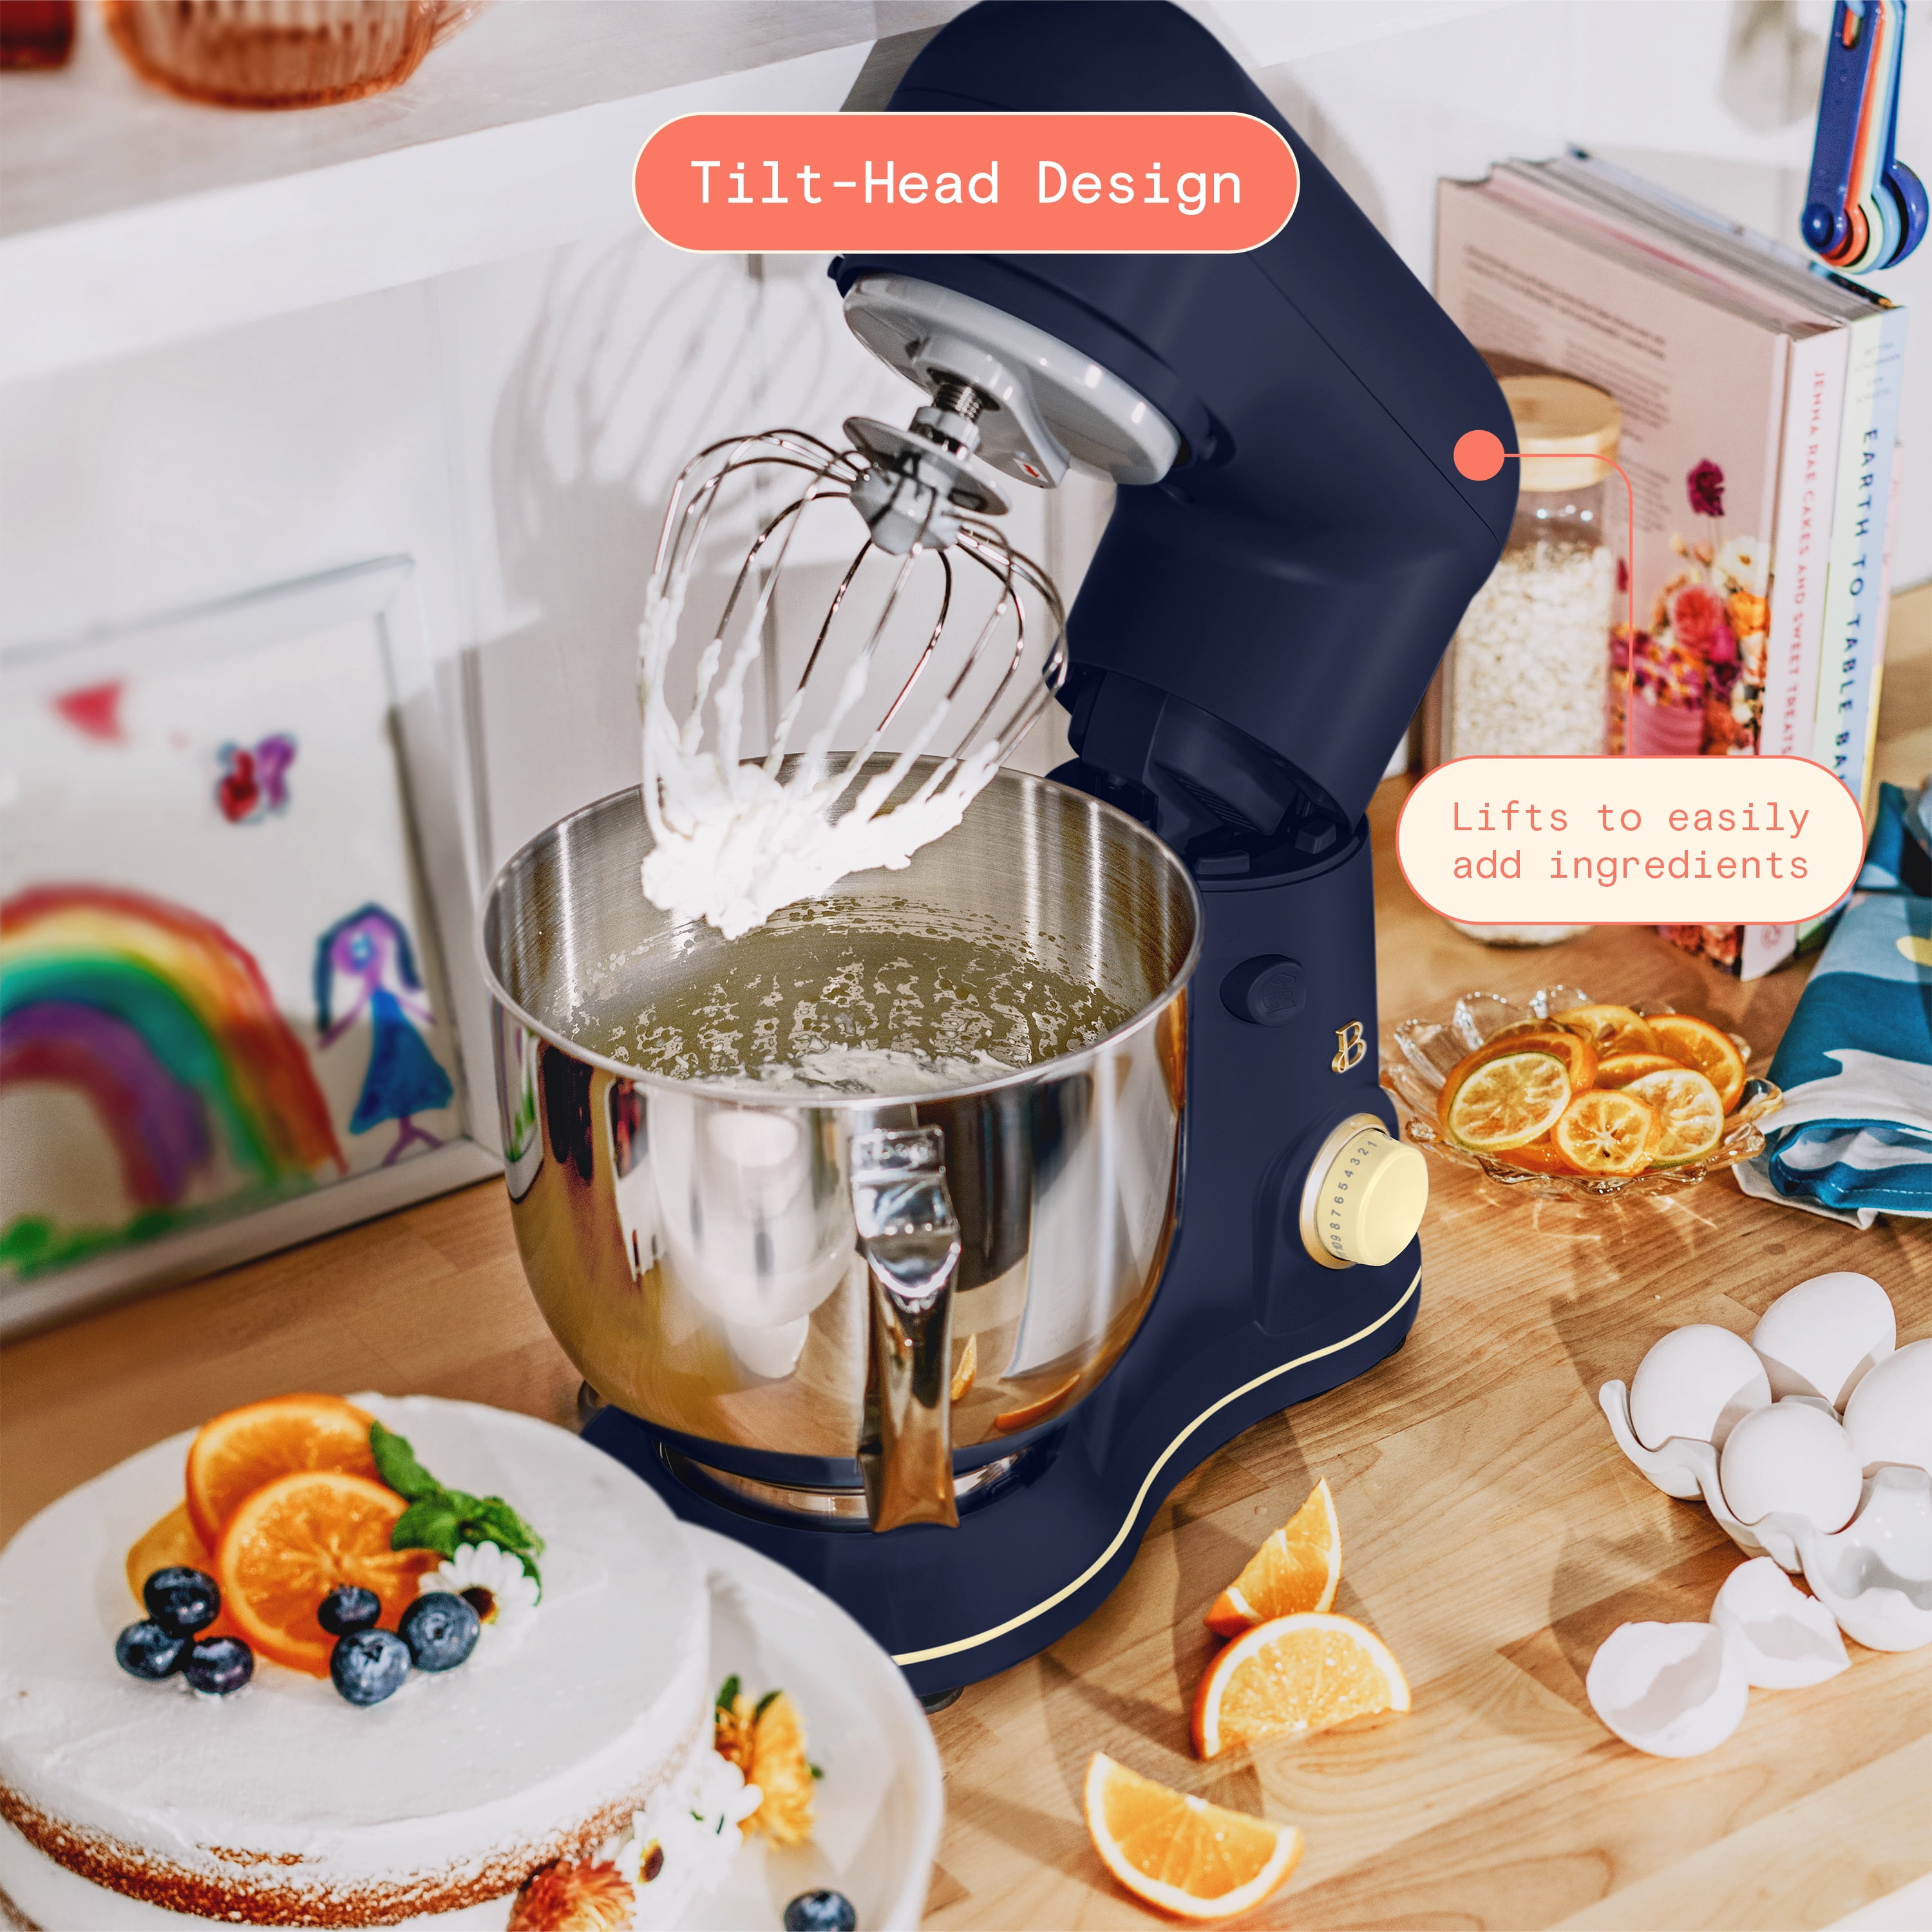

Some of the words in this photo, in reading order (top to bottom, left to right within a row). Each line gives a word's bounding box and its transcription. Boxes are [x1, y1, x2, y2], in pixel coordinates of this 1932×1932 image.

[1855, 428, 1879, 536] EARTH
[1799, 489, 1815, 555] CAKES
[1794, 564, 1807, 604] AND
[1849, 554, 1867, 596] TO
[1788, 612, 1804, 675] SWEET
[1838, 613, 1861, 714] TABLE
[1781, 683, 1798, 754] TREATS
[1331, 1020, 1367, 1074] B
[1344, 1170, 1354, 1178] 4
[1358, 1148, 1369, 1156] 2
[1334, 1196, 1344, 1204] 6
[1338, 1182, 1349, 1191] 5
